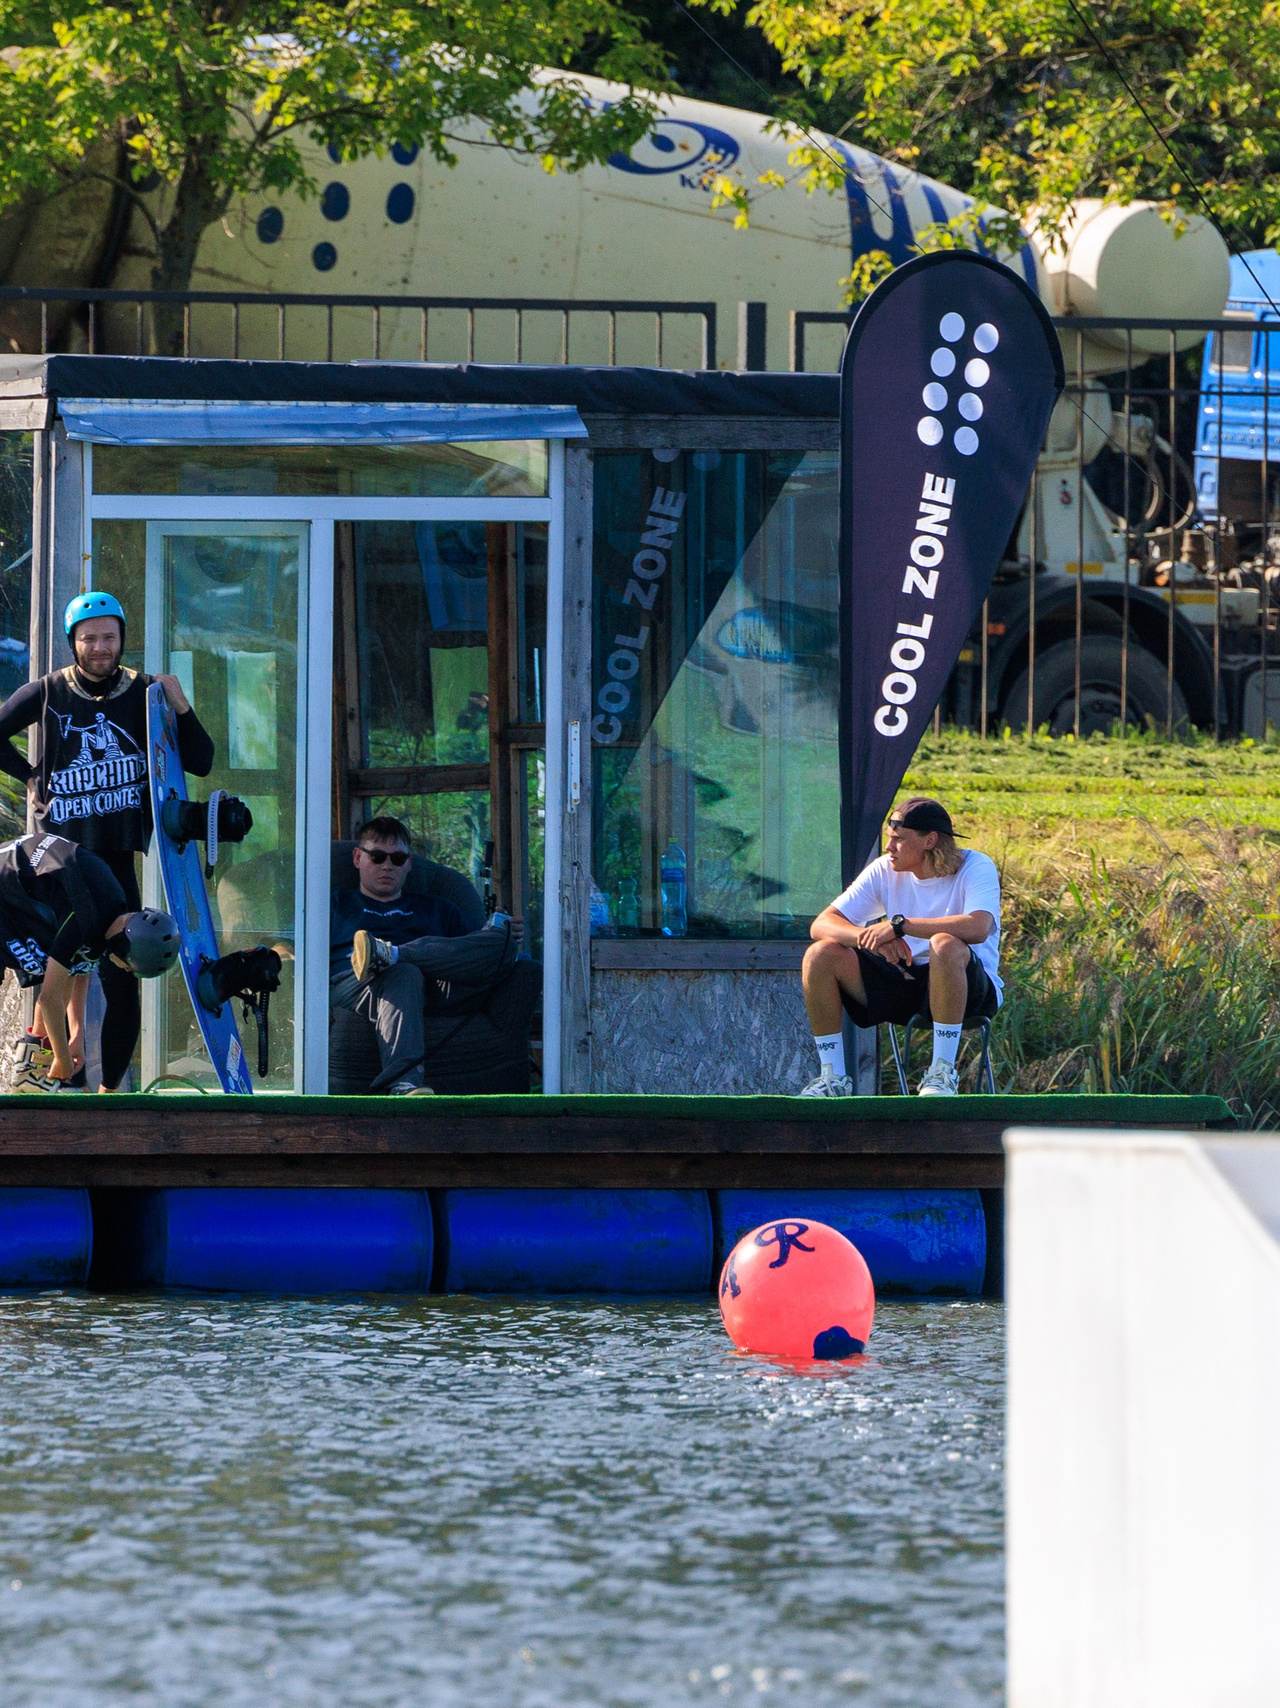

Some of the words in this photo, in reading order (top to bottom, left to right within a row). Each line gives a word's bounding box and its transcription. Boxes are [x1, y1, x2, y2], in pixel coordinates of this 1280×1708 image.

[901, 472, 956, 600] ZONE
[592, 625, 650, 745] COOL
[623, 485, 688, 613] ZONE
[873, 613, 934, 738] COOL
[51, 798, 90, 823] OPEN
[94, 784, 144, 815] CONTES
